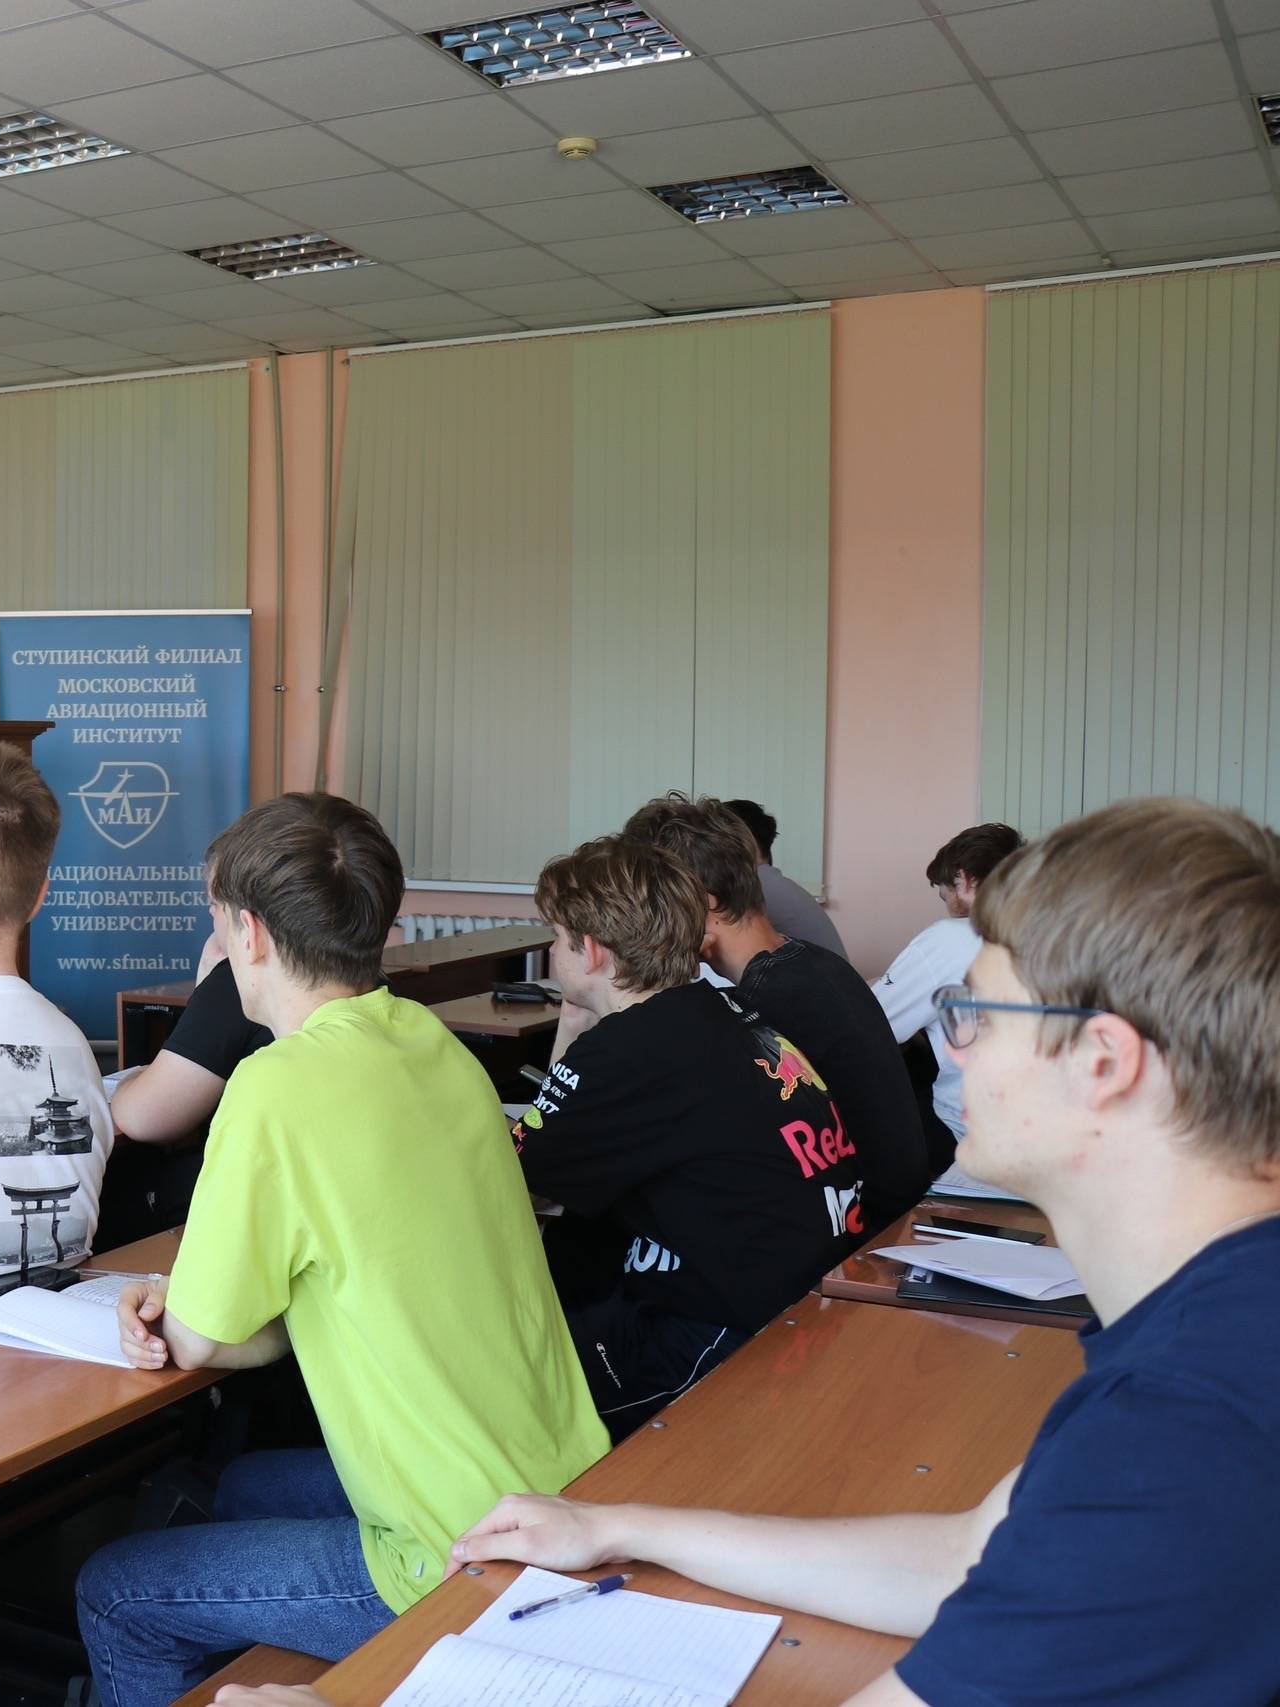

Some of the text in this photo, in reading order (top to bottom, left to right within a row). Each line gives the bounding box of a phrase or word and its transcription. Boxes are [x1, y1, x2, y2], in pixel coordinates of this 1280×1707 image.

[12, 645, 242, 666] СТУПИНСКИЙ ФИЛИАЛ
[57, 673, 196, 694] МОСКОВСКИЙ
[46, 699, 208, 721] АВИАЦИОННЫЙ
[73, 727, 182, 744] ИНСТИТУТ
[50, 916, 197, 932] УНИВЕРСИТЕТ
[56, 953, 191, 971] www.sfmai.ru
[551, 1062, 580, 1091] VISA
